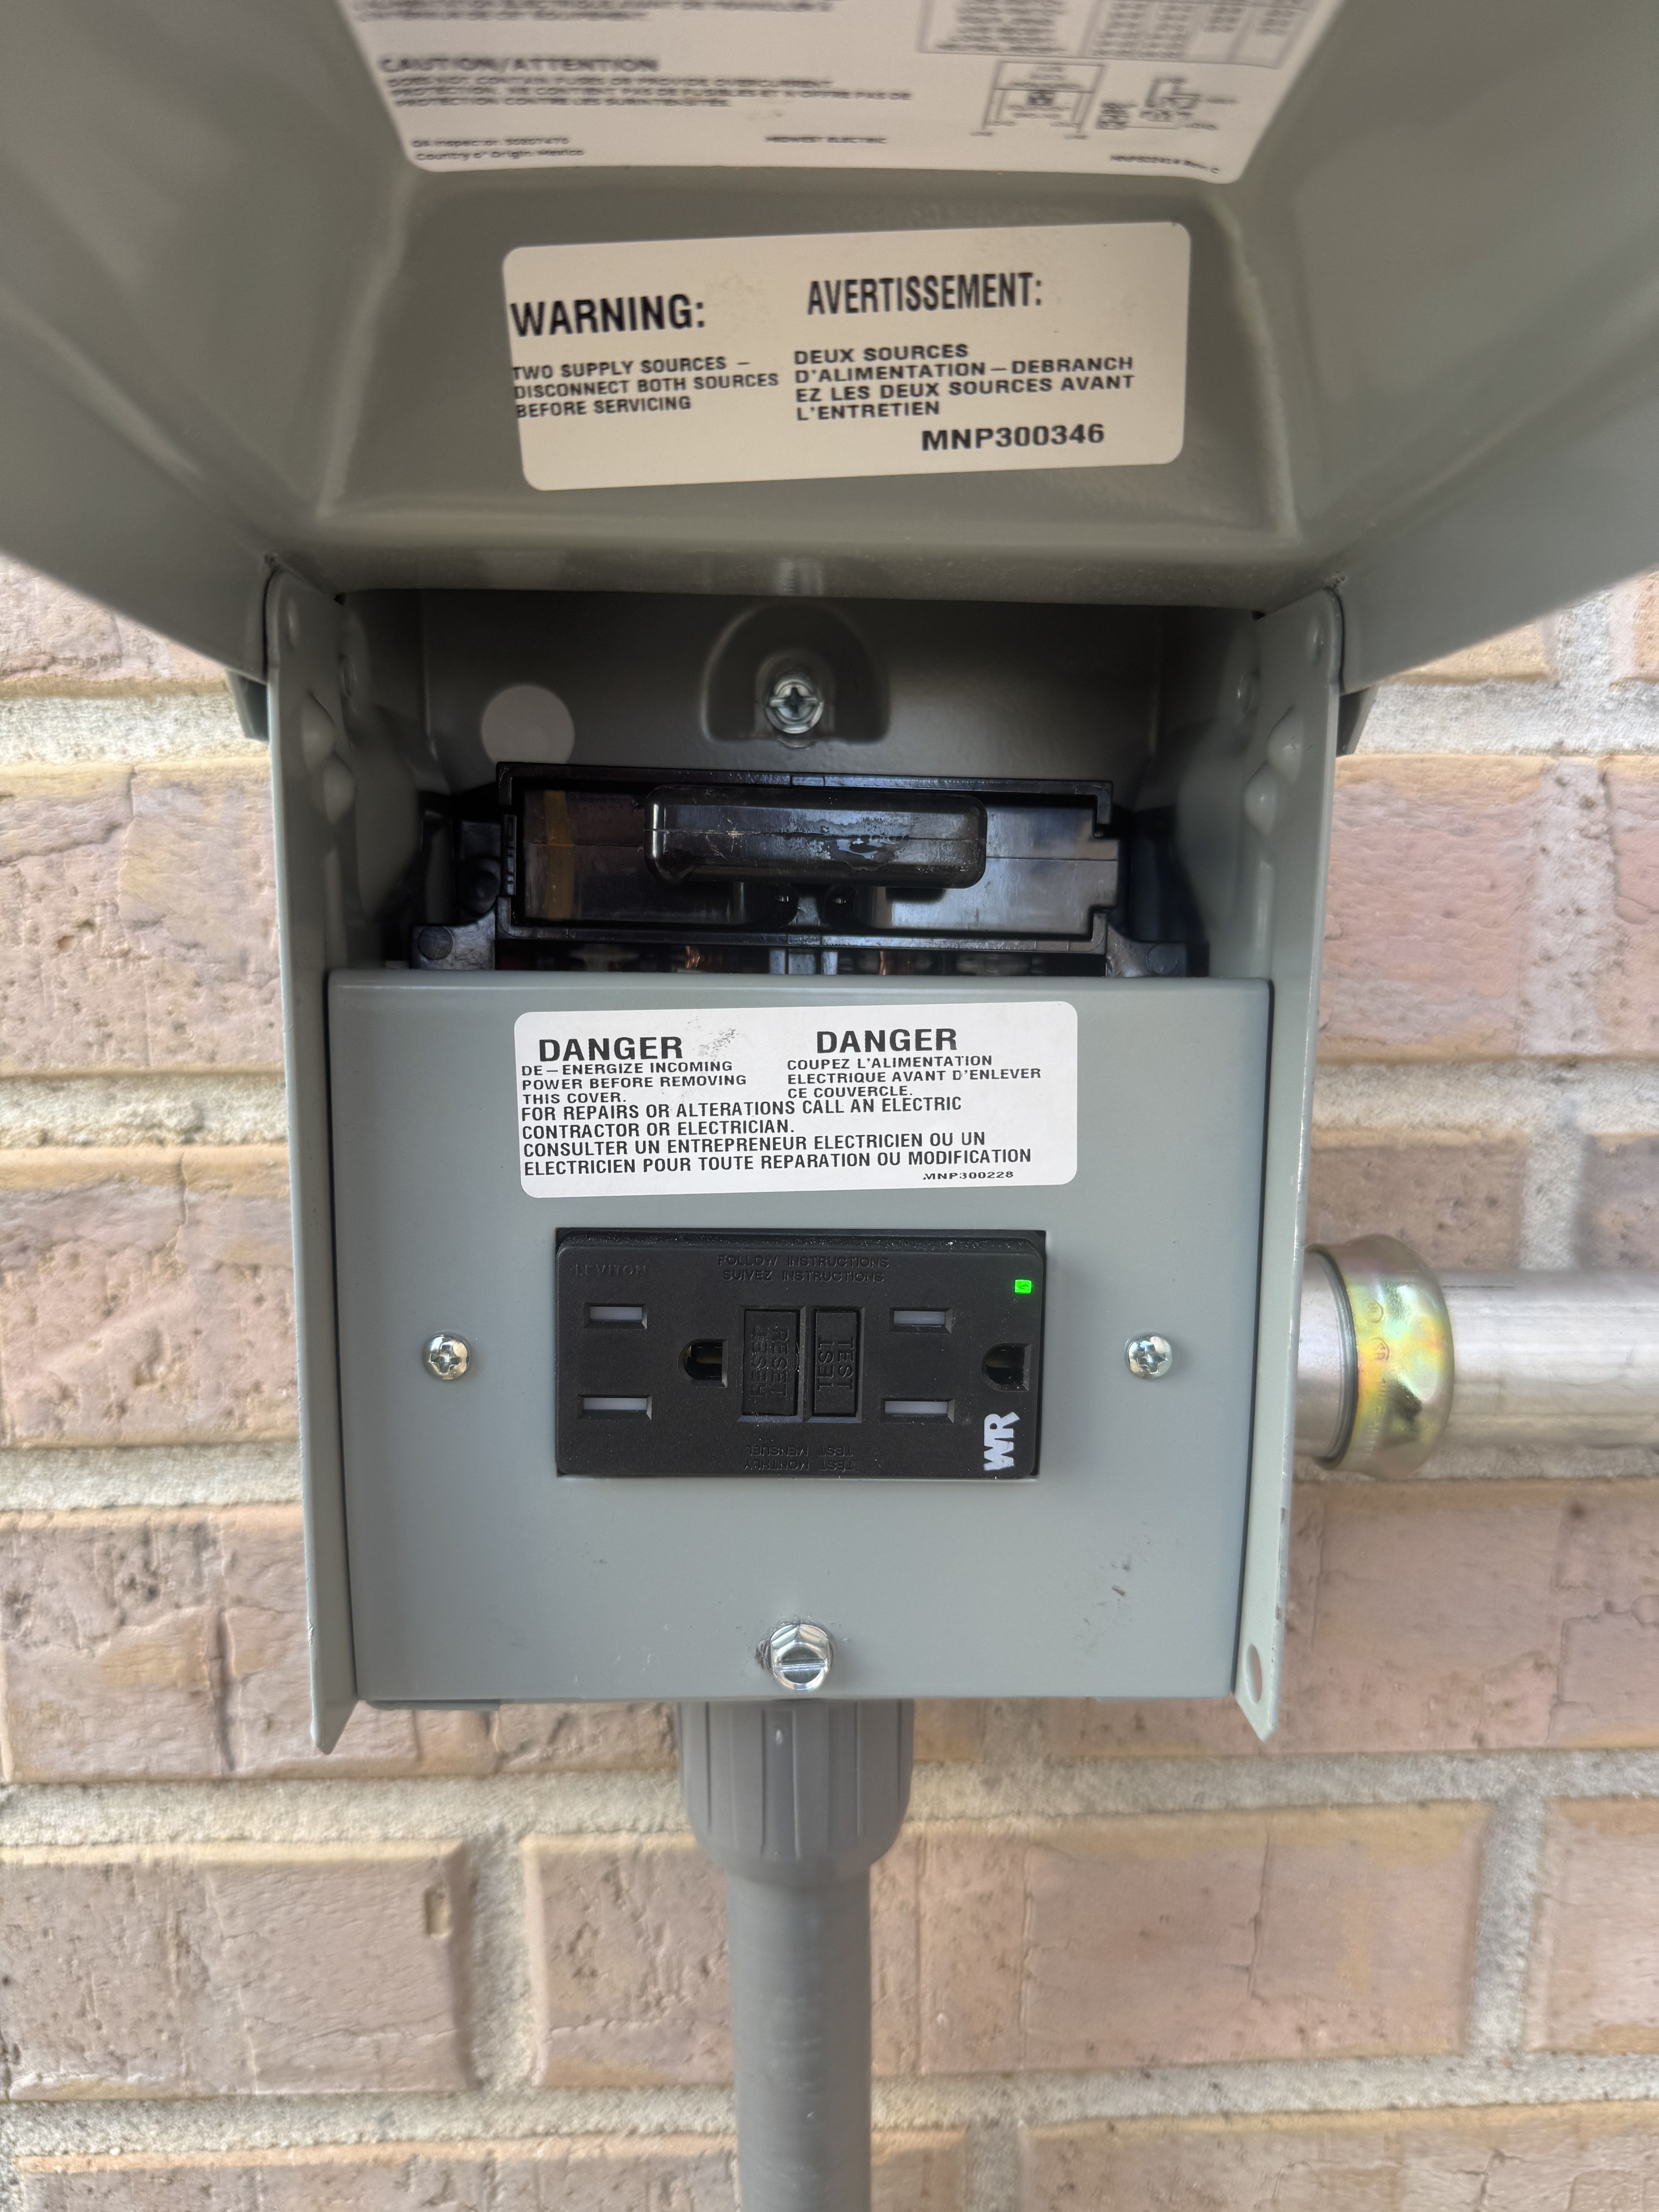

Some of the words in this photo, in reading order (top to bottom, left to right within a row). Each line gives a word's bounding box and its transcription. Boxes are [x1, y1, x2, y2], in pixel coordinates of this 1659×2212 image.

[380, 58, 658, 72] CAUTION/ATTENTION
[808, 272, 1041, 315] AVERTISSEMENT:
[510, 294, 704, 337] WARNING:
[794, 349, 854, 365] DEUX
[864, 343, 968, 361] SOURCES
[512, 366, 553, 381] TWO
[561, 361, 633, 378] SUPPLY
[641, 356, 726, 374] SOURCES
[1012, 357, 1132, 374] DEBRANCH
[514, 380, 629, 399] DISCONNECT
[637, 378, 686, 392] BOTH
[694, 373, 778, 390] SOURCES
[796, 388, 821, 402] EZ
[831, 386, 870, 401] LES
[880, 383, 939, 399] DEUX
[949, 378, 1052, 395] SOURCES
[1061, 375, 1135, 391] AVANT
[517, 402, 587, 418] BEFORE
[594, 396, 691, 414] SERVICING
[797, 401, 939, 421] L'ENTRETIEN
[922, 424, 1104, 451] MNP300346
[539, 1036, 683, 1062] DANGER
[817, 1028, 957, 1053] DANGER
[650, 1061, 732, 1073] INCOMING
[787, 1059, 850, 1070] COUPEZ
[857, 1055, 992, 1068] L'ALIMENTATION
[522, 1079, 582, 1091] POWER
[590, 1077, 653, 1089] BEFORE
[660, 1075, 746, 1087] REMOVING
[788, 1072, 886, 1084] ELECTRIQUE
[892, 1070, 946, 1082] AVANT
[952, 1068, 1041, 1080] D'ENLEVER
[522, 1094, 560, 1104] THIS
[567, 1092, 626, 1104] COVER.
[788, 1088, 807, 1099] CE
[814, 1085, 912, 1098] COUVERCLE.
[522, 1107, 556, 1121] FOR
[563, 1104, 639, 1120] REPAIRS
[646, 1104, 670, 1118] OR
[676, 1101, 795, 1117] ALTERATIONS
[802, 1099, 844, 1114] CALL
[850, 1099, 874, 1113] AN
[882, 1096, 961, 1112] ELECTRIC
[522, 1123, 640, 1139] CONTRACTOR
[647, 1122, 670, 1136] OR
[678, 1119, 794, 1136] ELECTRICIAN.
[524, 1141, 628, 1157] CONSULTER
[635, 1140, 659, 1154] UN
[668, 1136, 807, 1154] ENTREPRENEUR
[814, 1133, 922, 1150] ELECTRICIEN
[930, 1132, 953, 1146] OU
[962, 1132, 985, 1146] UN
[525, 1159, 635, 1176] ELECTRICIEN
[643, 1158, 691, 1173] POUR
[698, 1156, 754, 1171] TOUTE
[761, 1152, 870, 1169] REPARATION
[878, 1152, 900, 1166] OU
[908, 1149, 1030, 1165] MODIFICATION
[923, 1171, 1013, 1180] MNP300228
[573, 1263, 646, 1276] LEVITON
[718, 1254, 778, 1267] FOLLOW
[787, 1255, 890, 1268] INSTRUCTIONS
[723, 1269, 773, 1282] SUIVEZ
[782, 1270, 884, 1283] INSTRUCTIONS
[771, 1328, 789, 1398] RESET
[817, 1337, 834, 1391] TEST
[837, 1337, 855, 1391] TEST
[745, 1446, 809, 1456] MENSUEL
[818, 1446, 853, 1456] TEST
[984, 1412, 1020, 1471] WR
[744, 1460, 810, 1470] MONTHLY
[819, 1460, 855, 1471] TEST
